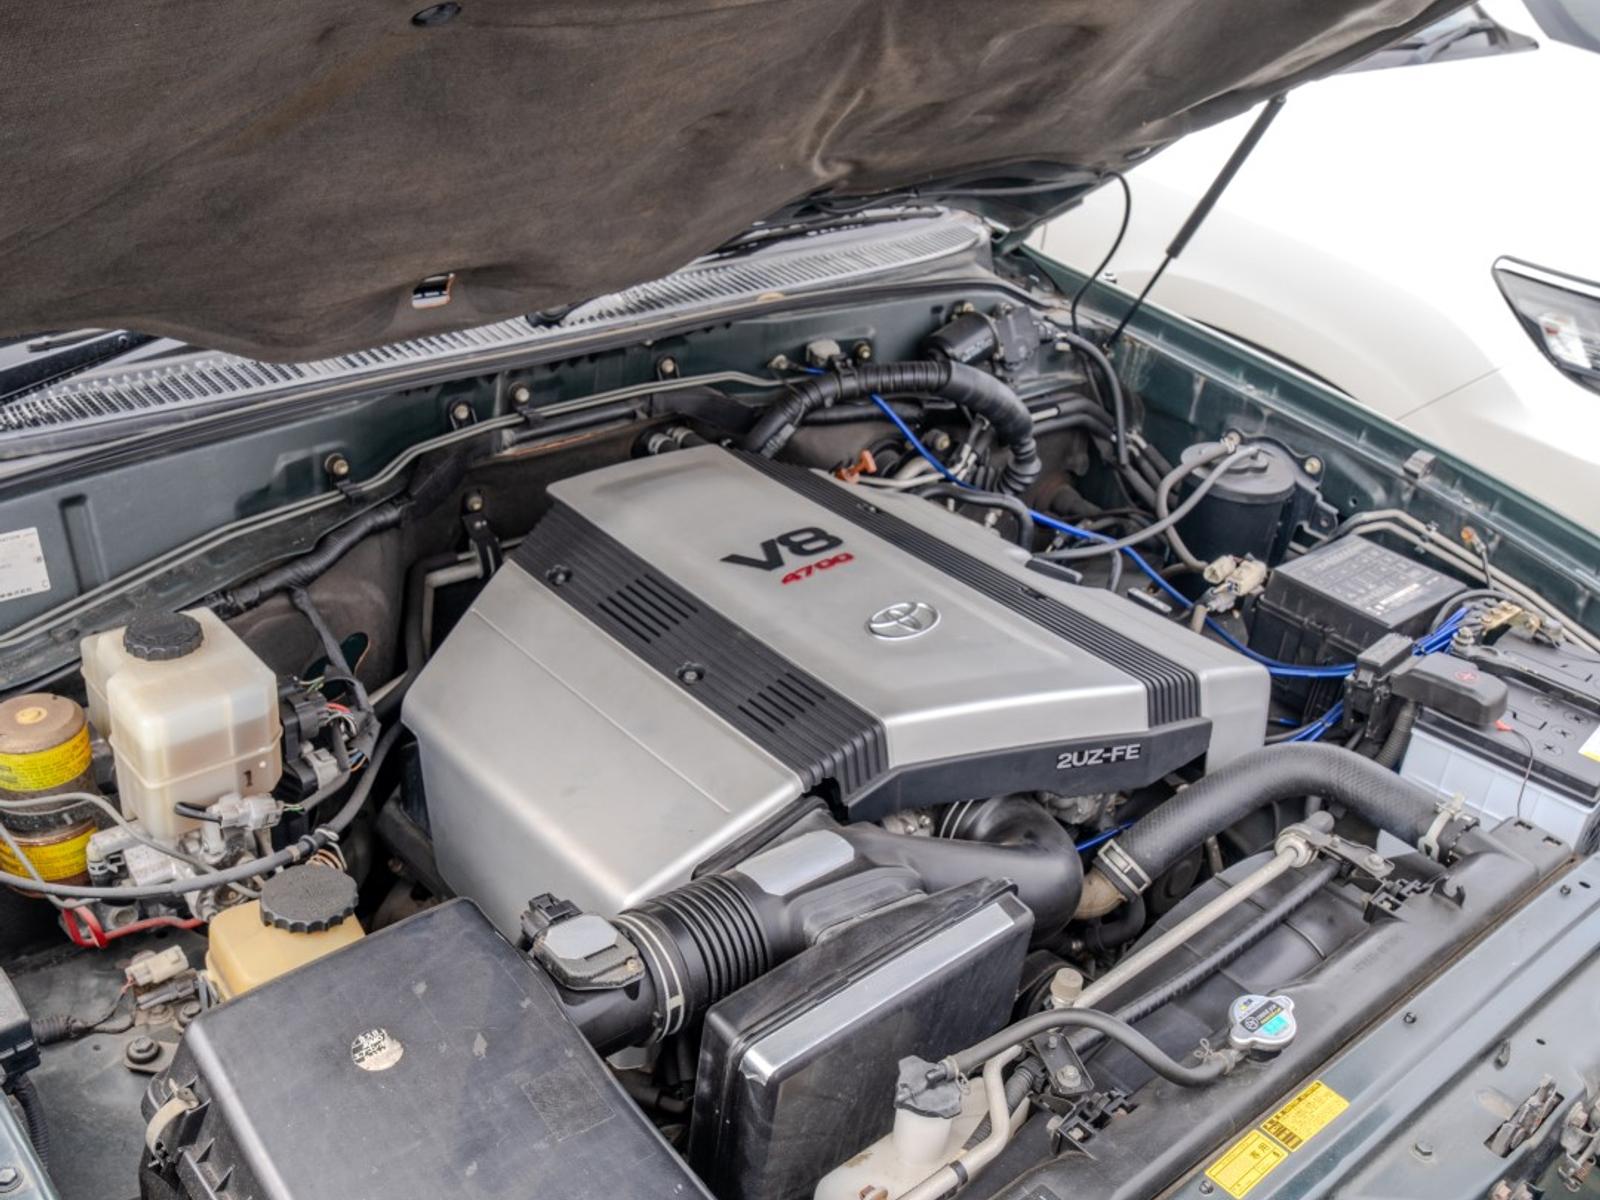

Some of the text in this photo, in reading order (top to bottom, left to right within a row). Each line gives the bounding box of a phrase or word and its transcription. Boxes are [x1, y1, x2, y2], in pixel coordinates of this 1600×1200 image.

[720, 526, 843, 571] V8
[782, 553, 853, 584] 4700
[1056, 743, 1141, 769] 2UZ-FE
